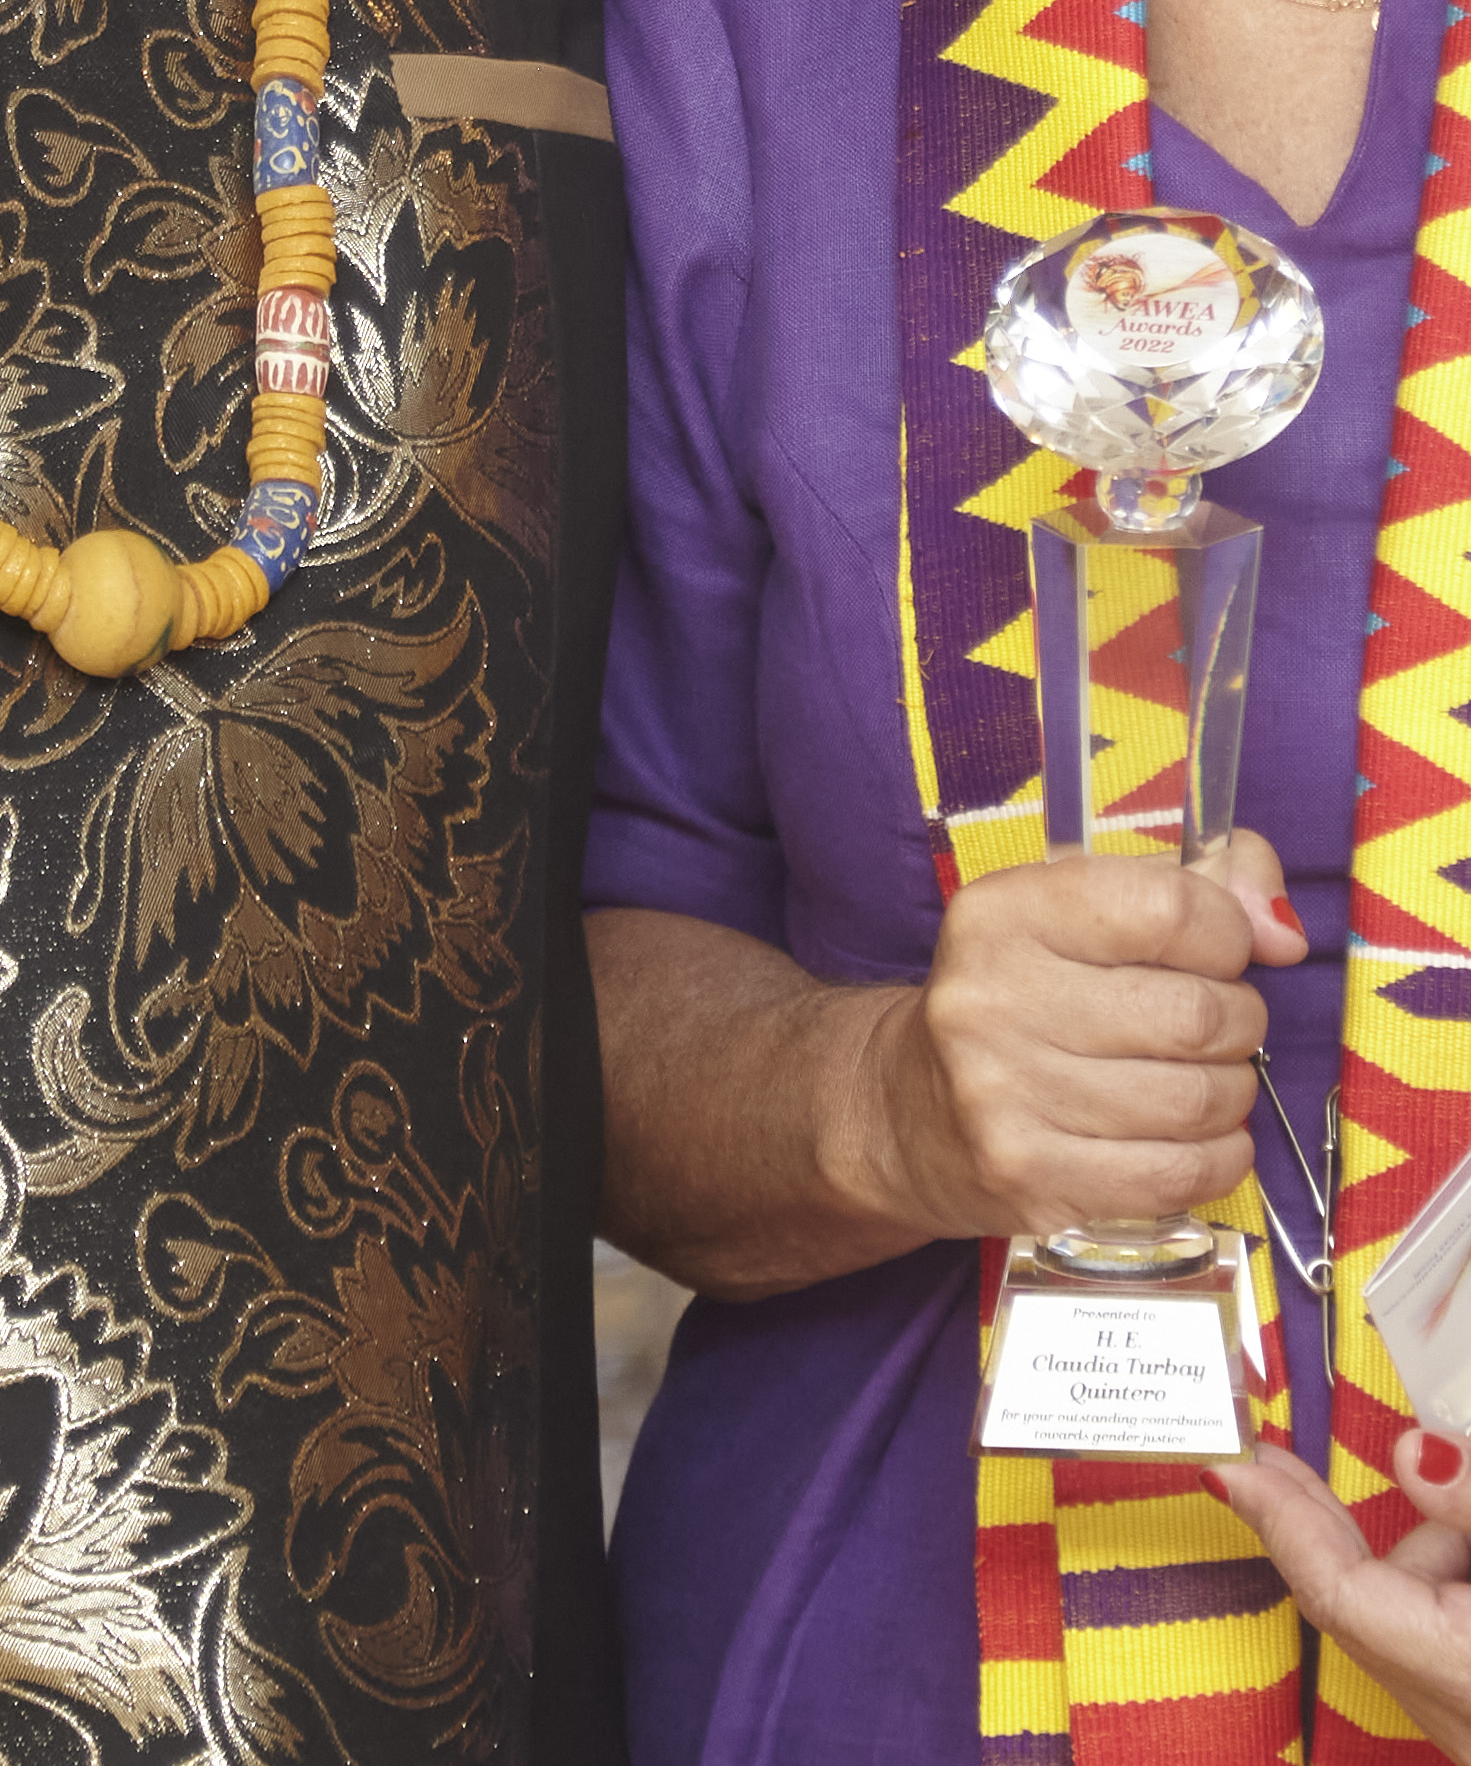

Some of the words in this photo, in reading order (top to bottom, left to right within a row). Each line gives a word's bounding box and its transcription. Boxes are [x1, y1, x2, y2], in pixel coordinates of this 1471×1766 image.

[1132, 298, 1216, 322] AWEA
[1099, 317, 1204, 338] Awards
[1119, 338, 1175, 355] 2022
[1073, 1308, 1139, 1321] Presented
[1143, 1309, 1156, 1321] to
[1096, 1330, 1117, 1348] H.
[1125, 1331, 1142, 1349] E.
[1032, 1354, 1118, 1374] Claudia
[1128, 1357, 1206, 1384] Turbay
[1069, 1381, 1167, 1405] Quintero
[1023, 1413, 1053, 1425] your
[1057, 1411, 1138, 1428] outstanding
[1141, 1415, 1223, 1427] contribution
[1035, 1430, 1089, 1441] towards
[1093, 1431, 1141, 1446] gender
[1141, 1432, 1186, 1446] justice
